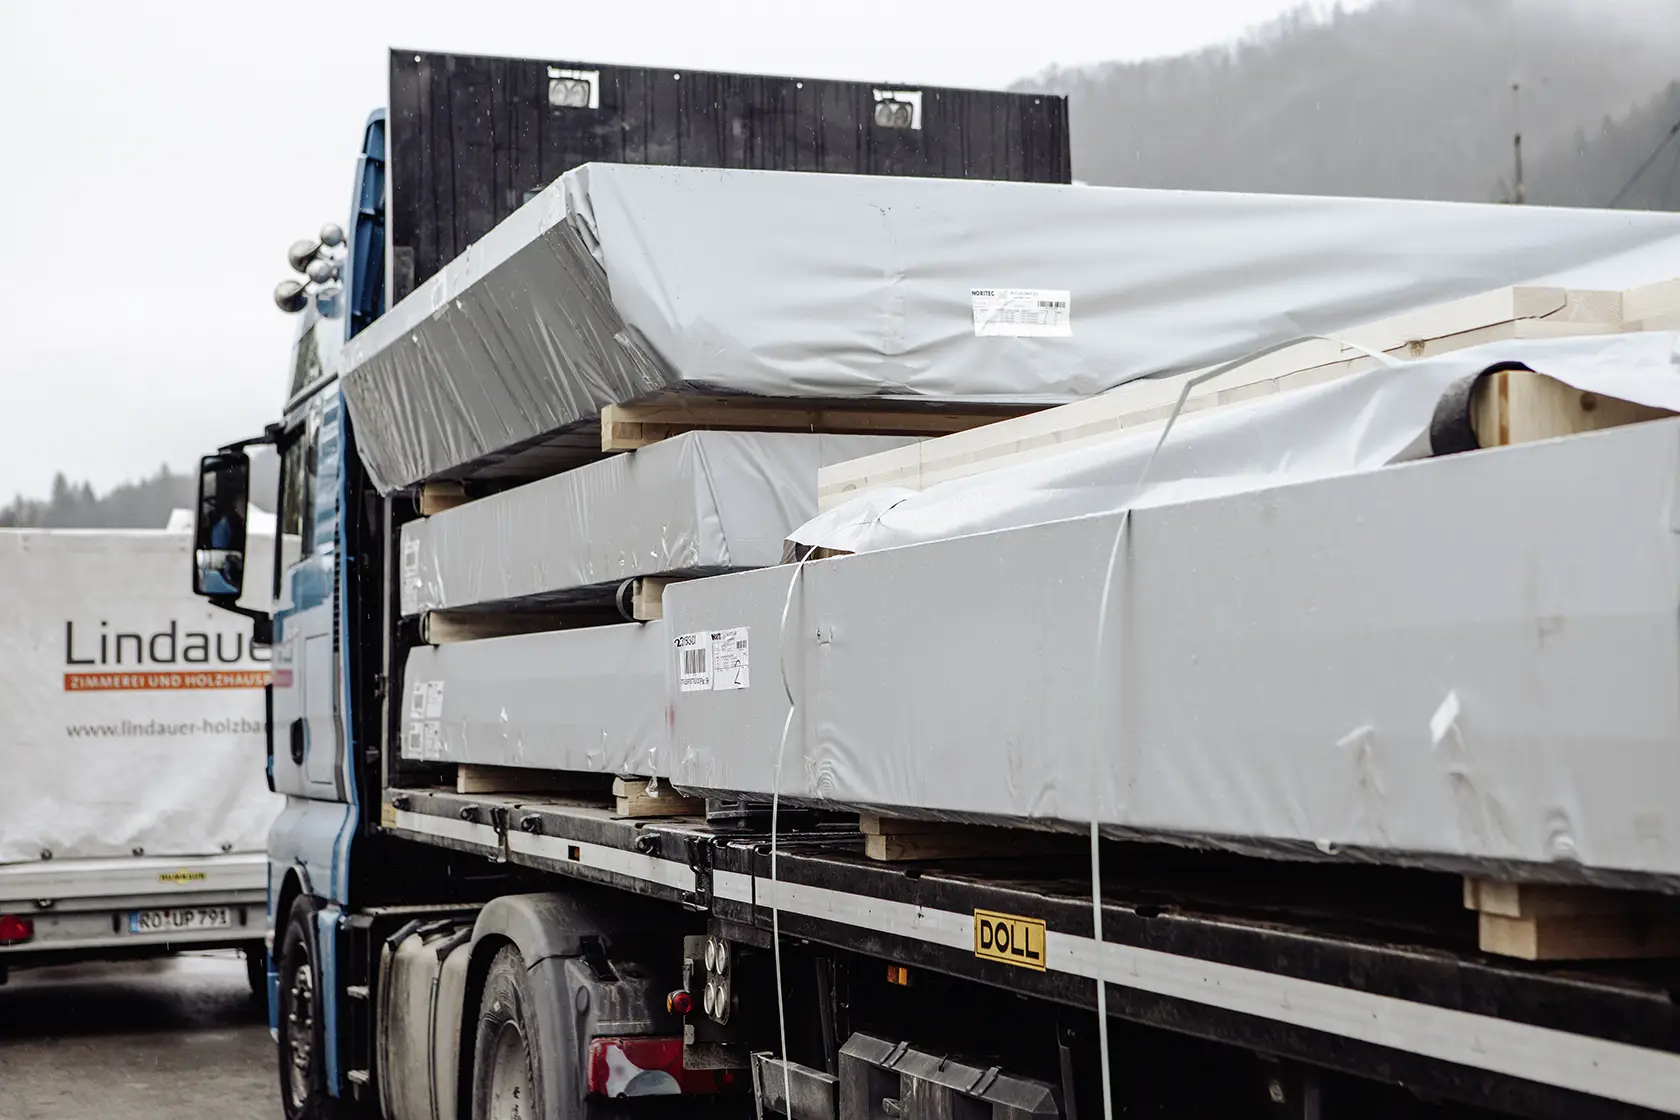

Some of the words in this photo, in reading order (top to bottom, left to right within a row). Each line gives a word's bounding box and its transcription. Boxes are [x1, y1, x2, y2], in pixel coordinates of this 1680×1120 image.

[70, 675, 145, 689] ZIMMEREI
[149, 674, 182, 688] UND
[66, 718, 267, 738] www.lindauer-holzba
[172, 910, 194, 927] UP
[980, 918, 1040, 960] DOLL
